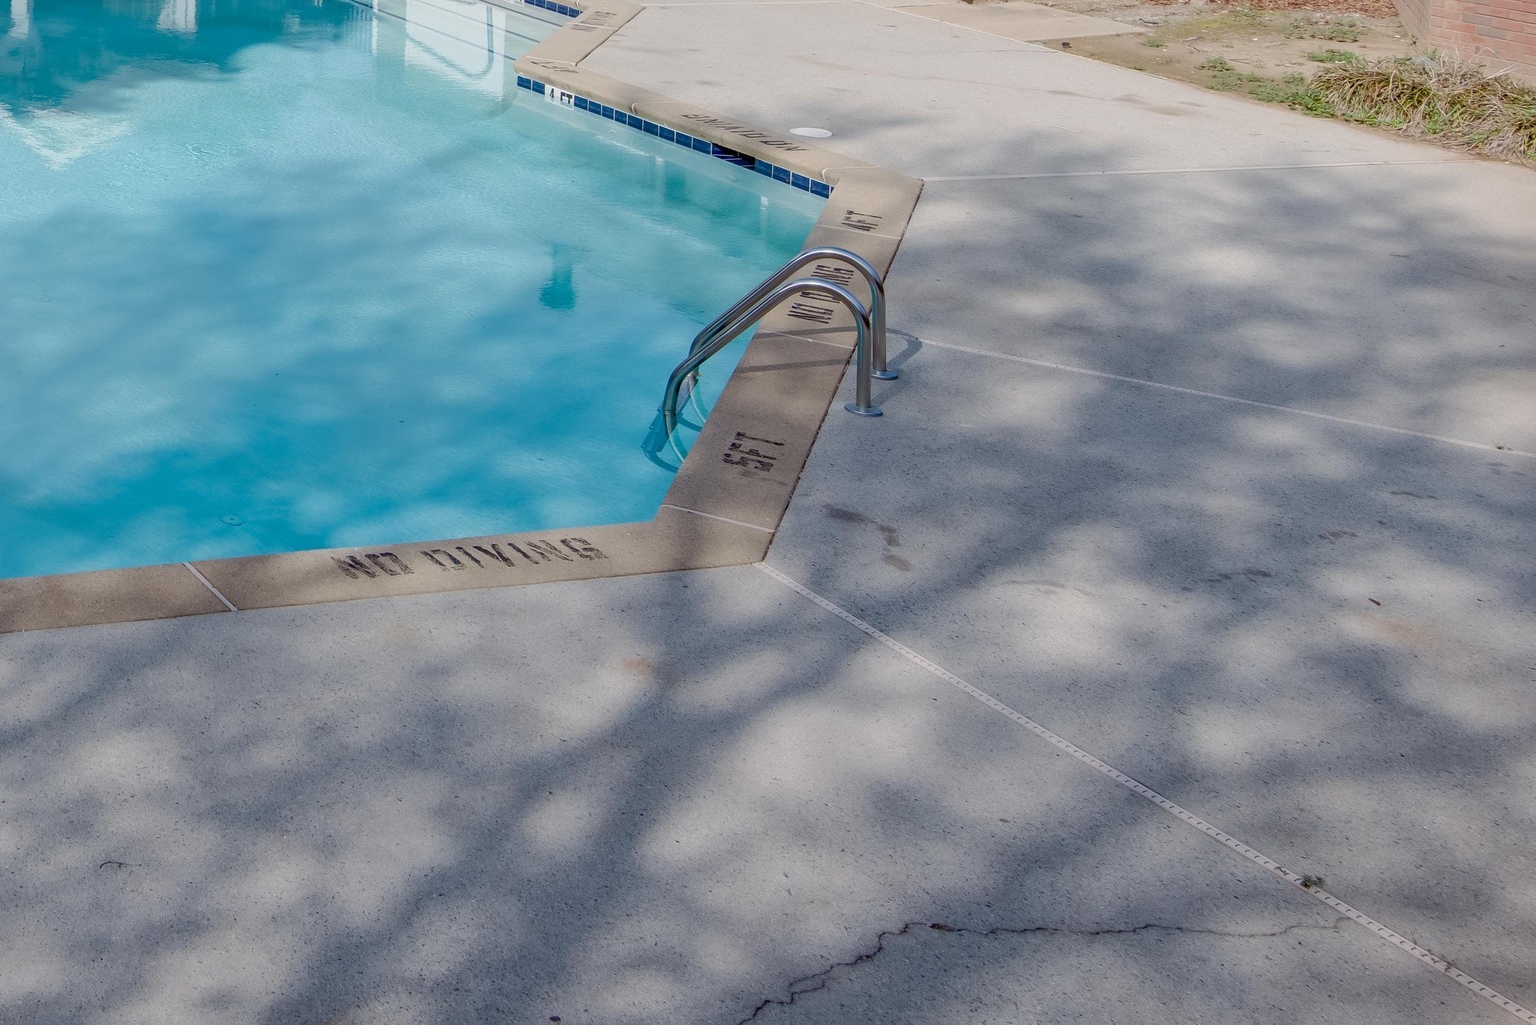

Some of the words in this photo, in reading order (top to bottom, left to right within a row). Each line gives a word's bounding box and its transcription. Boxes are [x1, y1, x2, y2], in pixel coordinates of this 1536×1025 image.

[787, 302, 834, 324] NO
[330, 551, 415, 580] NO
[419, 537, 610, 572] DIVING
